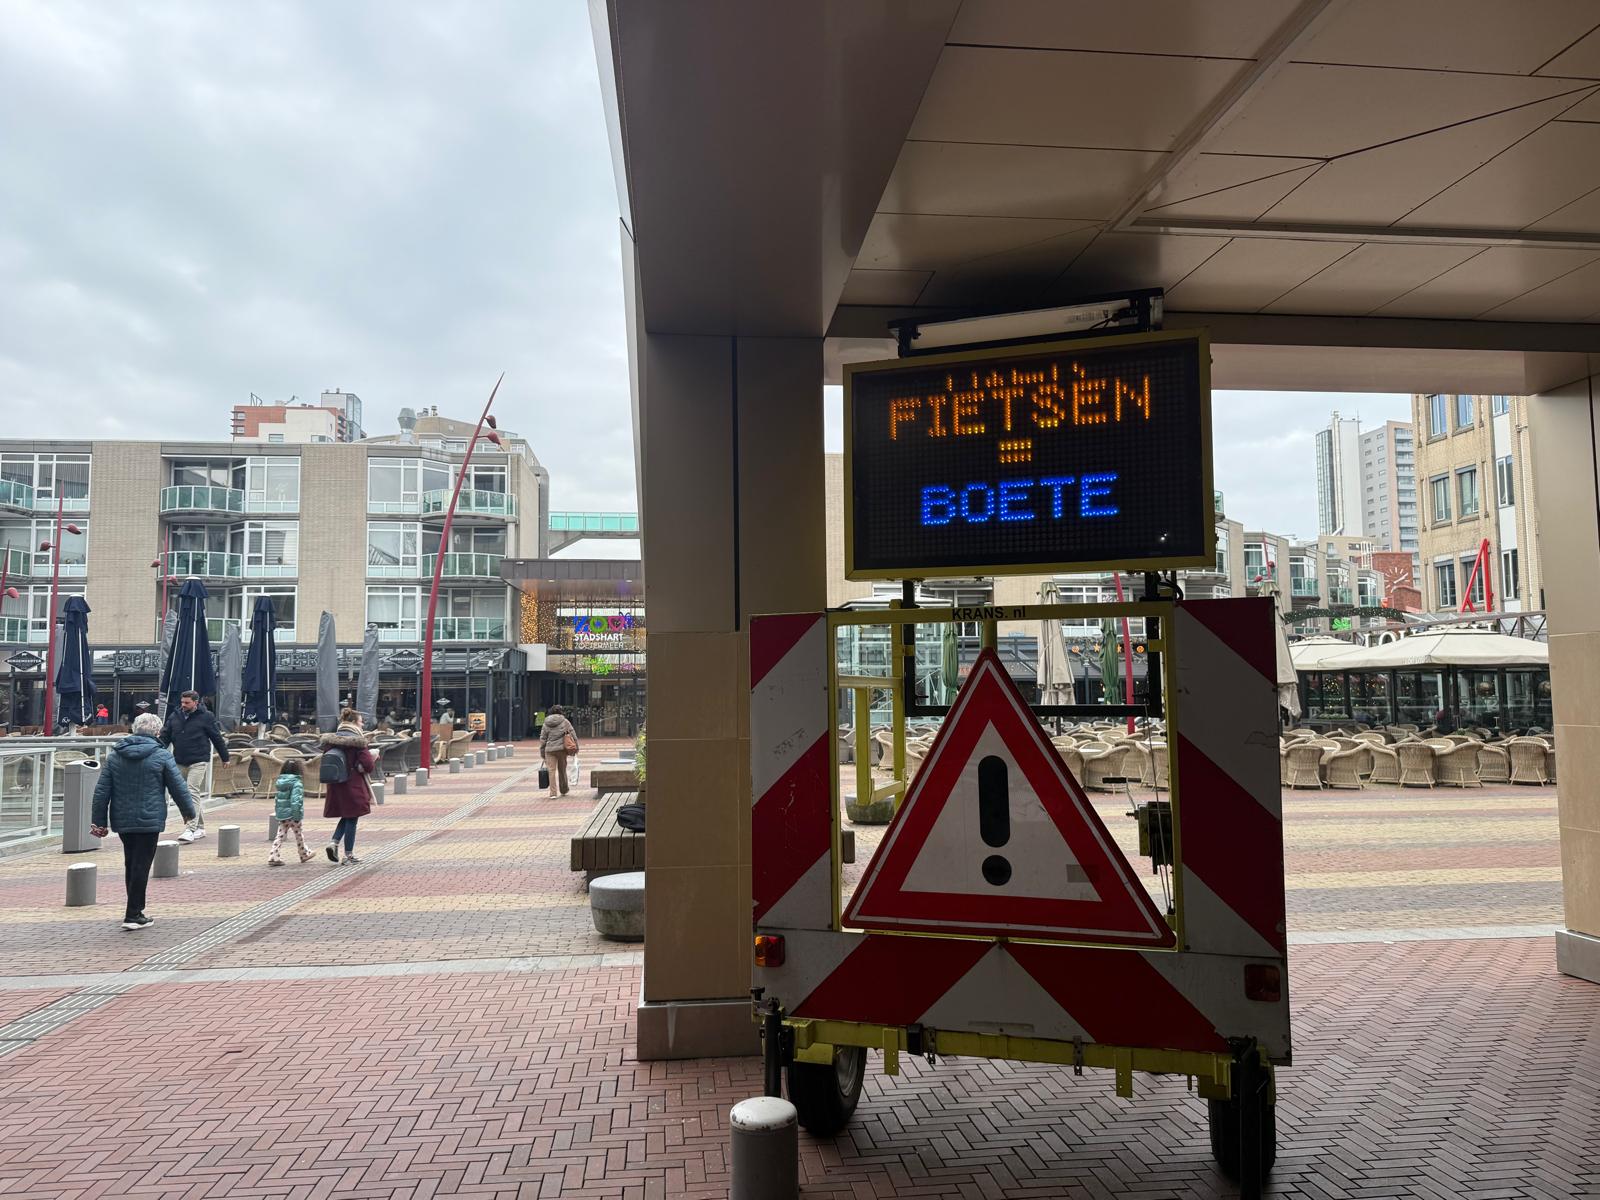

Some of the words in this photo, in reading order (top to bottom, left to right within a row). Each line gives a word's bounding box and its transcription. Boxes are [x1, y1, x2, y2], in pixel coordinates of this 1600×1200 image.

[888, 374, 1152, 441] FIETSEN
[919, 472, 1121, 527] BOETE
[574, 633, 624, 641] STADSHART
